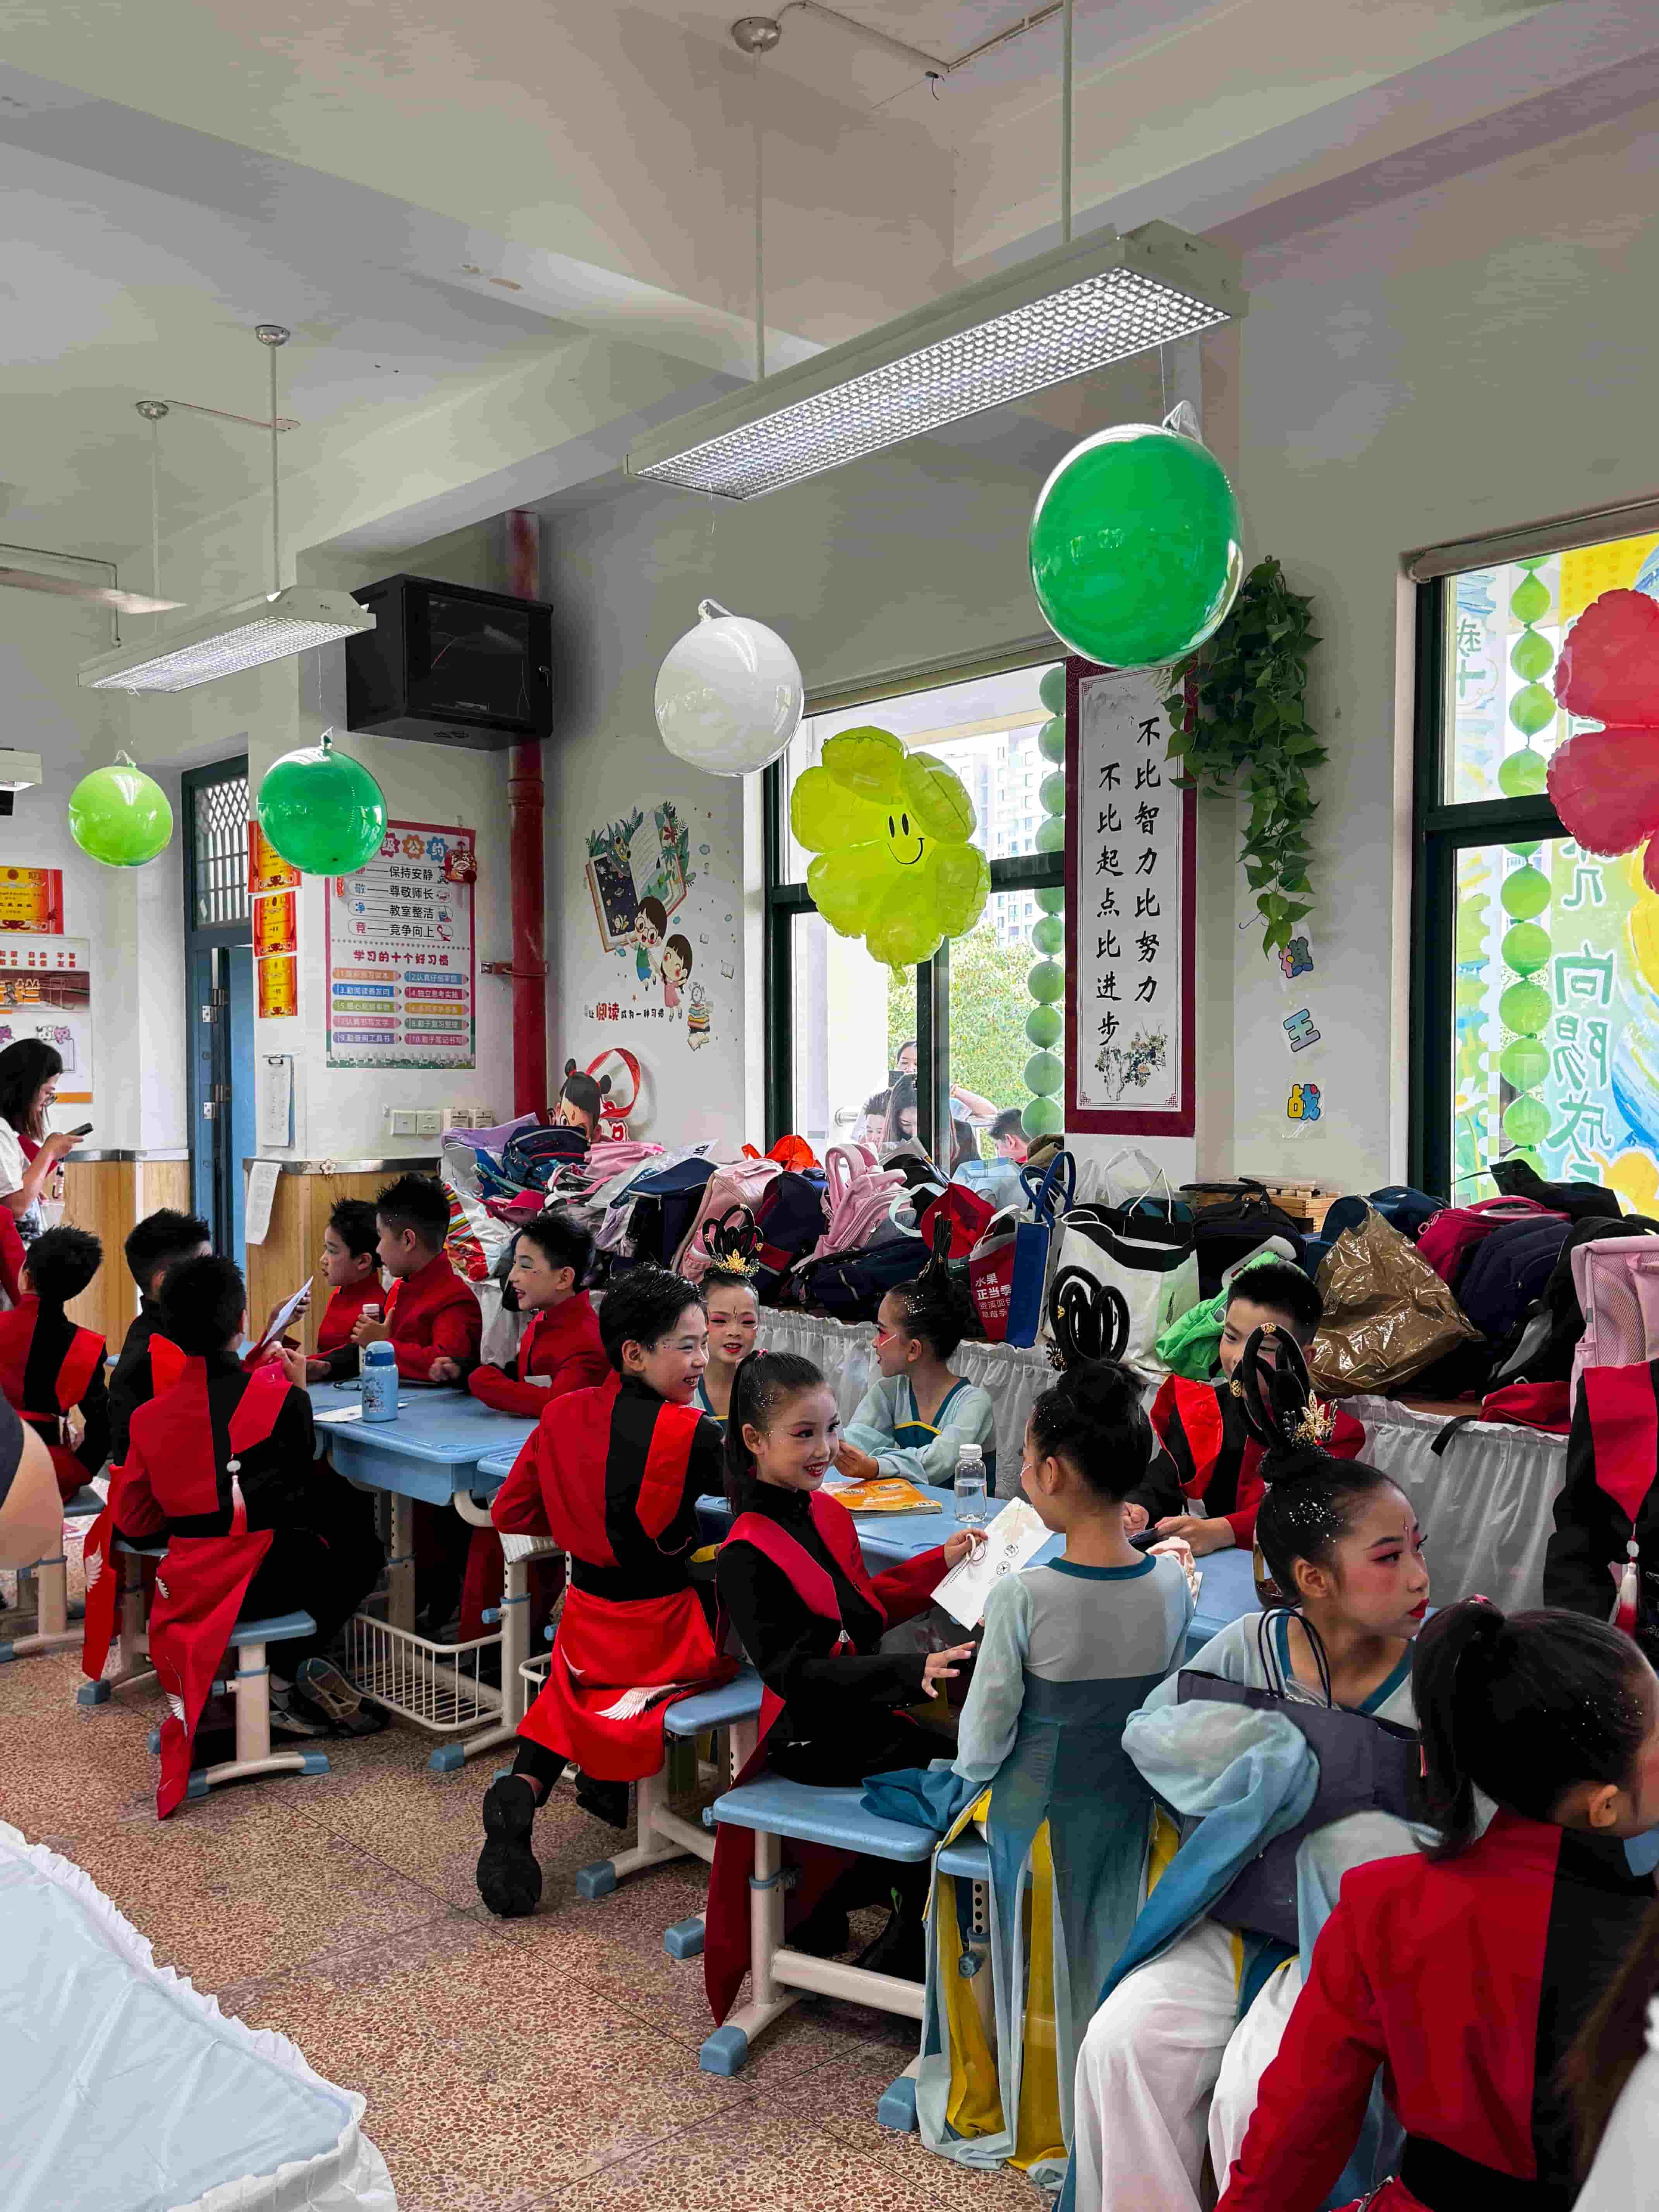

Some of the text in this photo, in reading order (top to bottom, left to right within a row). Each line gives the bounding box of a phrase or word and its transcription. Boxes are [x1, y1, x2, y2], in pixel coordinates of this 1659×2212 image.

[1135, 717, 1160, 1003] 不比智力比努力
[389, 866, 433, 880] 保持安静
[389, 885, 434, 900] 尊敬师长
[389, 904, 434, 919] 教室整洁
[1096, 763, 1123, 1045] 不比起点比进步
[390, 924, 434, 938] 竞争向上
[353, 950, 449, 966] 学习的十个好习惯
[589, 1001, 664, 1021] 让阅读成为一种习惯
[975, 1273, 998, 1287] 水果
[976, 1284, 1012, 1300] 正当季
